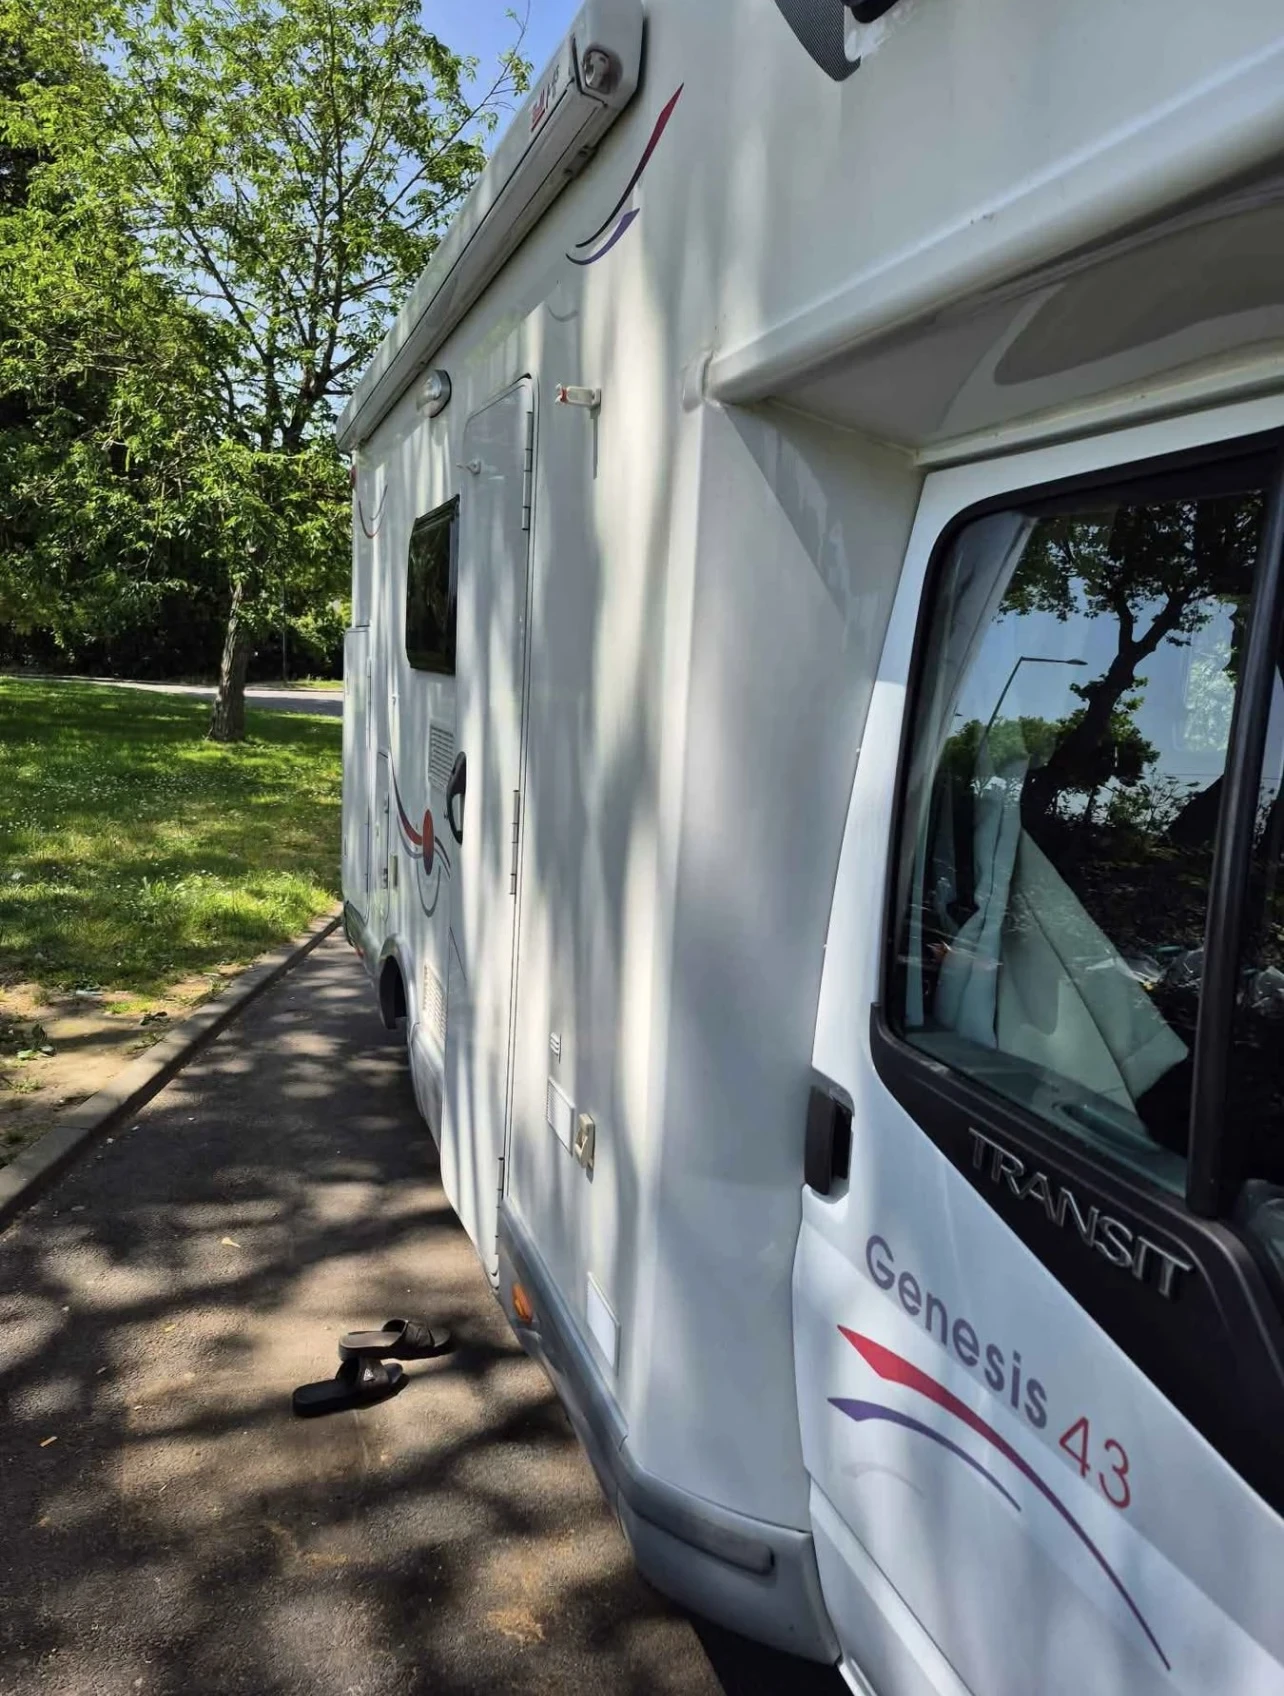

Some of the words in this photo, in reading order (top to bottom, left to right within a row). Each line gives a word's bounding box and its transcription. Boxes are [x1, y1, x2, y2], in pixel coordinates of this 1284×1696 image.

[968, 1126, 1194, 1299] TRANSIT
[865, 1234, 1049, 1430] Genesis
[1058, 1416, 1132, 1510] 43
